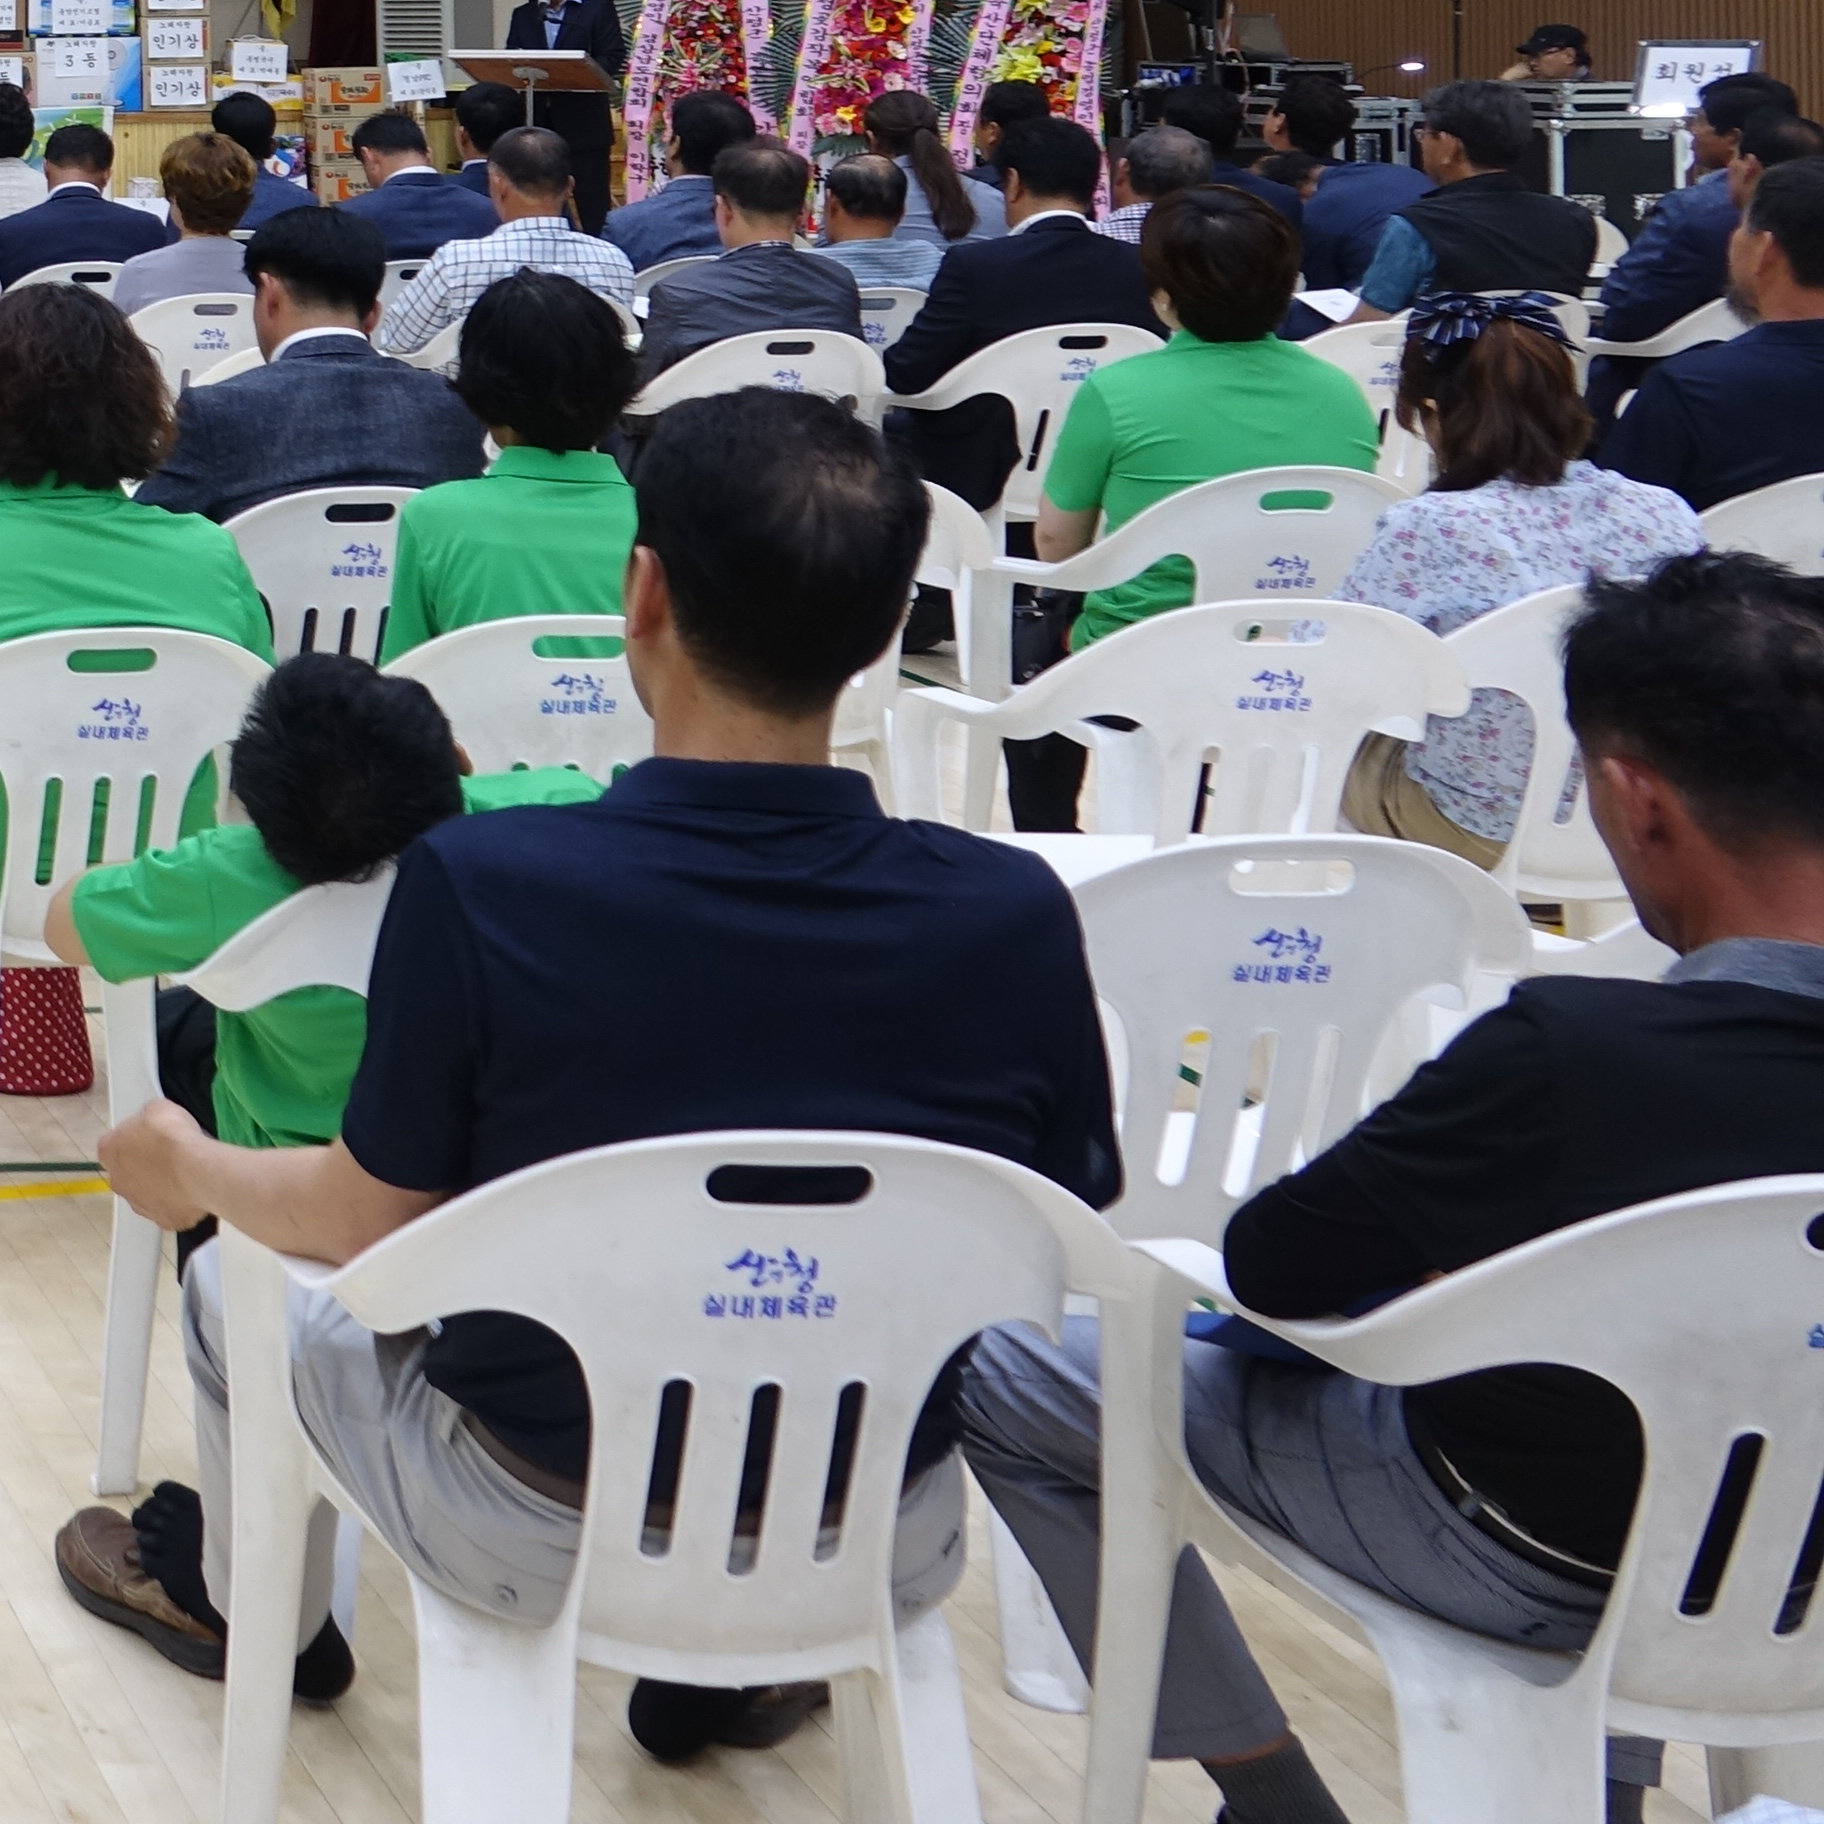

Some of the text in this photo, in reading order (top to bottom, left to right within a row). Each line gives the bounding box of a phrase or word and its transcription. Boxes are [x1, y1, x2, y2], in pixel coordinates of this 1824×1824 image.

[153, 34, 199, 49] 인기상
[155, 81, 202, 97] 인기상
[331, 564, 388, 578] 실내체육관
[540, 698, 618, 716] 실내체육관
[1235, 695, 1312, 712] 실내체육관
[77, 724, 149, 741] 실내체육관
[1232, 964, 1332, 984] 실내체육관
[703, 1293, 839, 1319] 실내체육관
